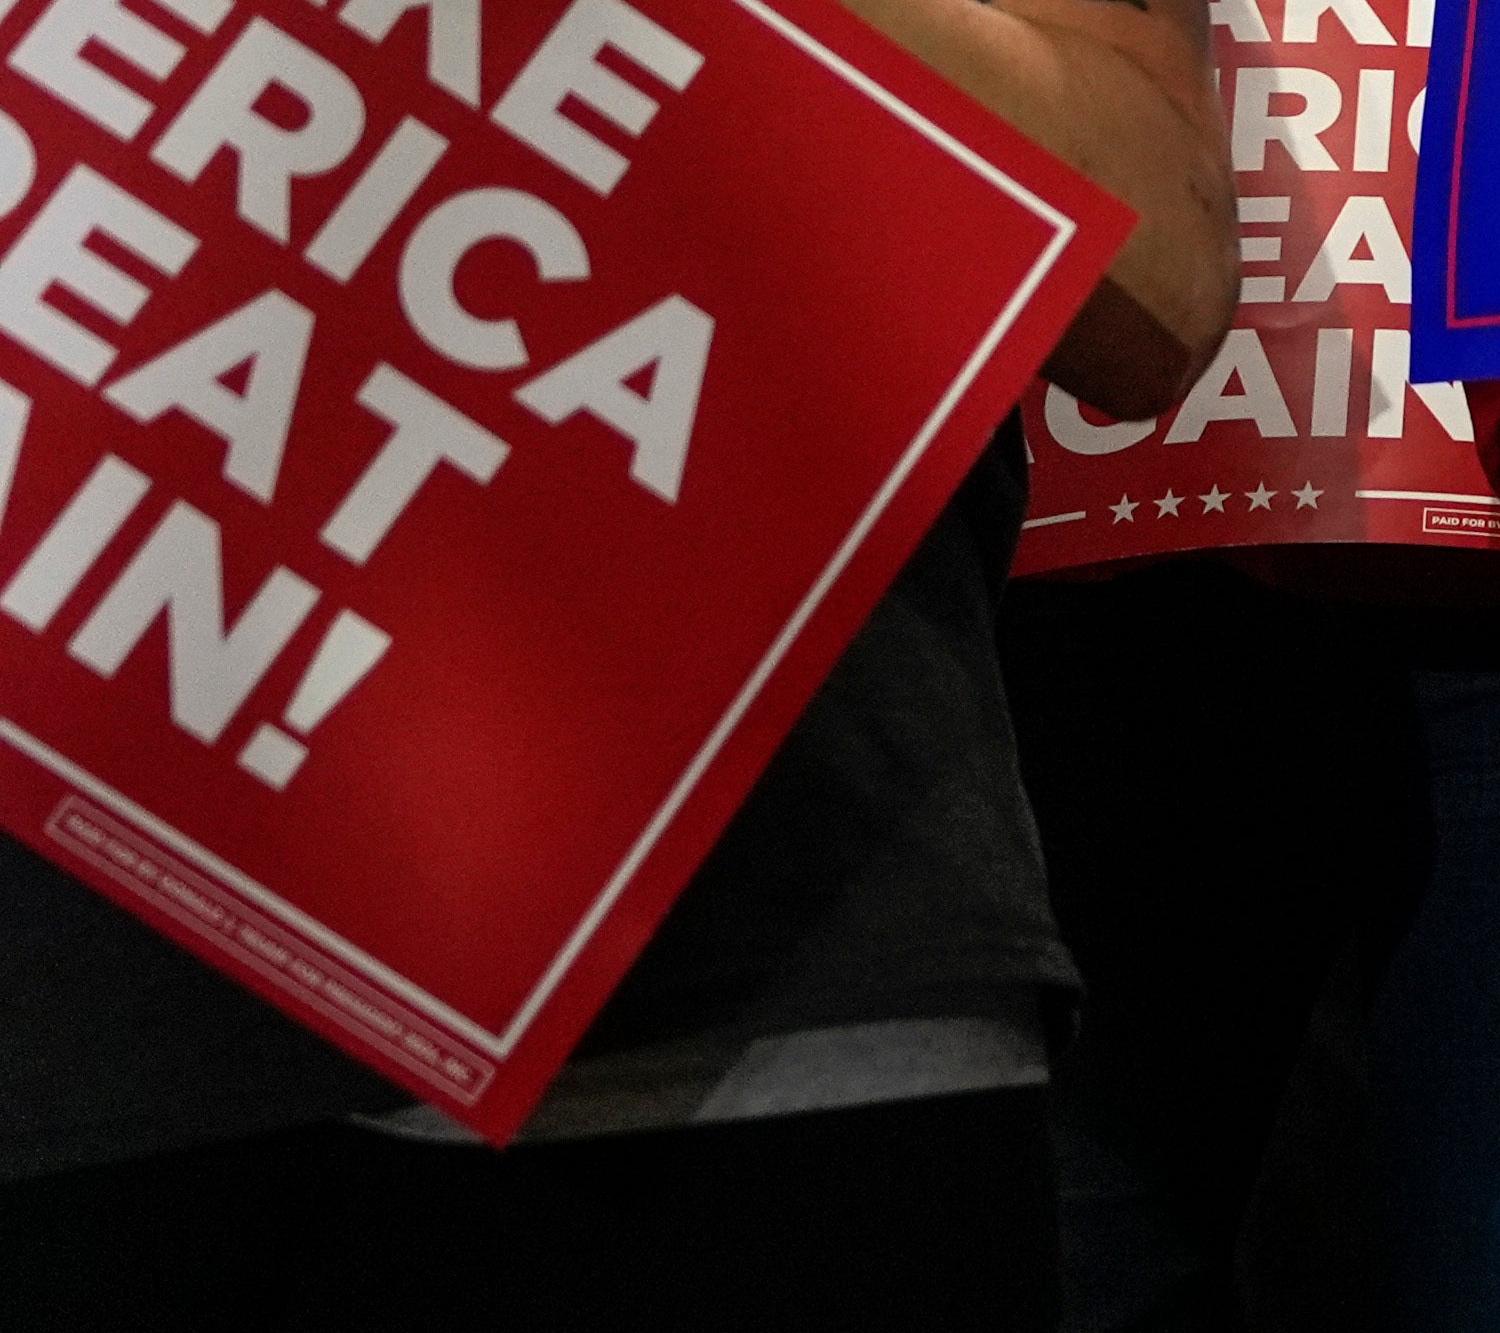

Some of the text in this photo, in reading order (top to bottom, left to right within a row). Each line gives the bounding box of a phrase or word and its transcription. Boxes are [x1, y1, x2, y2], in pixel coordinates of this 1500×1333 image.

[0, 113, 512, 568] EAT
[1431, 516, 1460, 526] PAID
[1461, 518, 1486, 528] FOR
[0, 383, 392, 792] IN!
